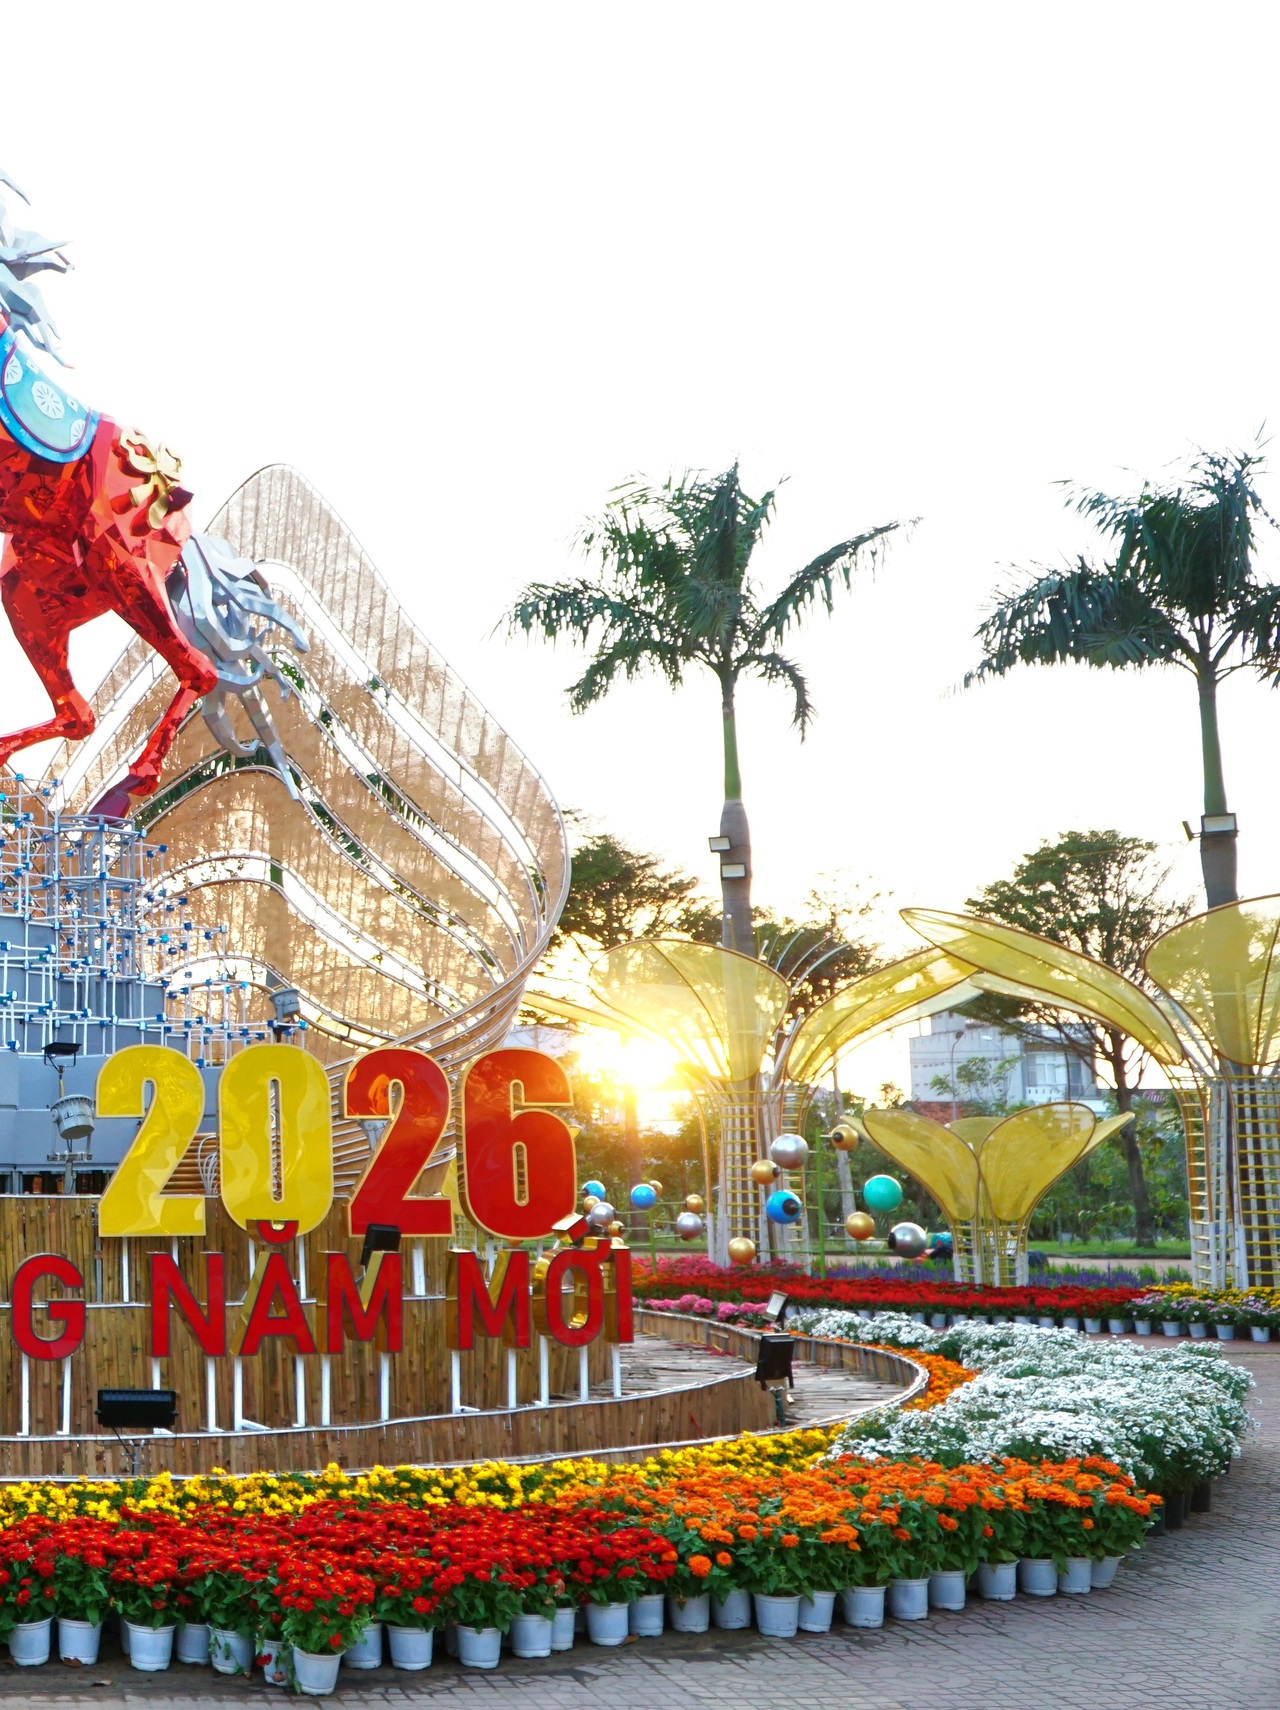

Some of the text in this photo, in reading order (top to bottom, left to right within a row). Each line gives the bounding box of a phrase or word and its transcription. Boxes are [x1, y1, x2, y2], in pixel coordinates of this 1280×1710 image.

[95, 1043, 578, 1240] 2026
[147, 1219, 403, 1357] NĂM
[449, 1213, 634, 1350] MỚI
